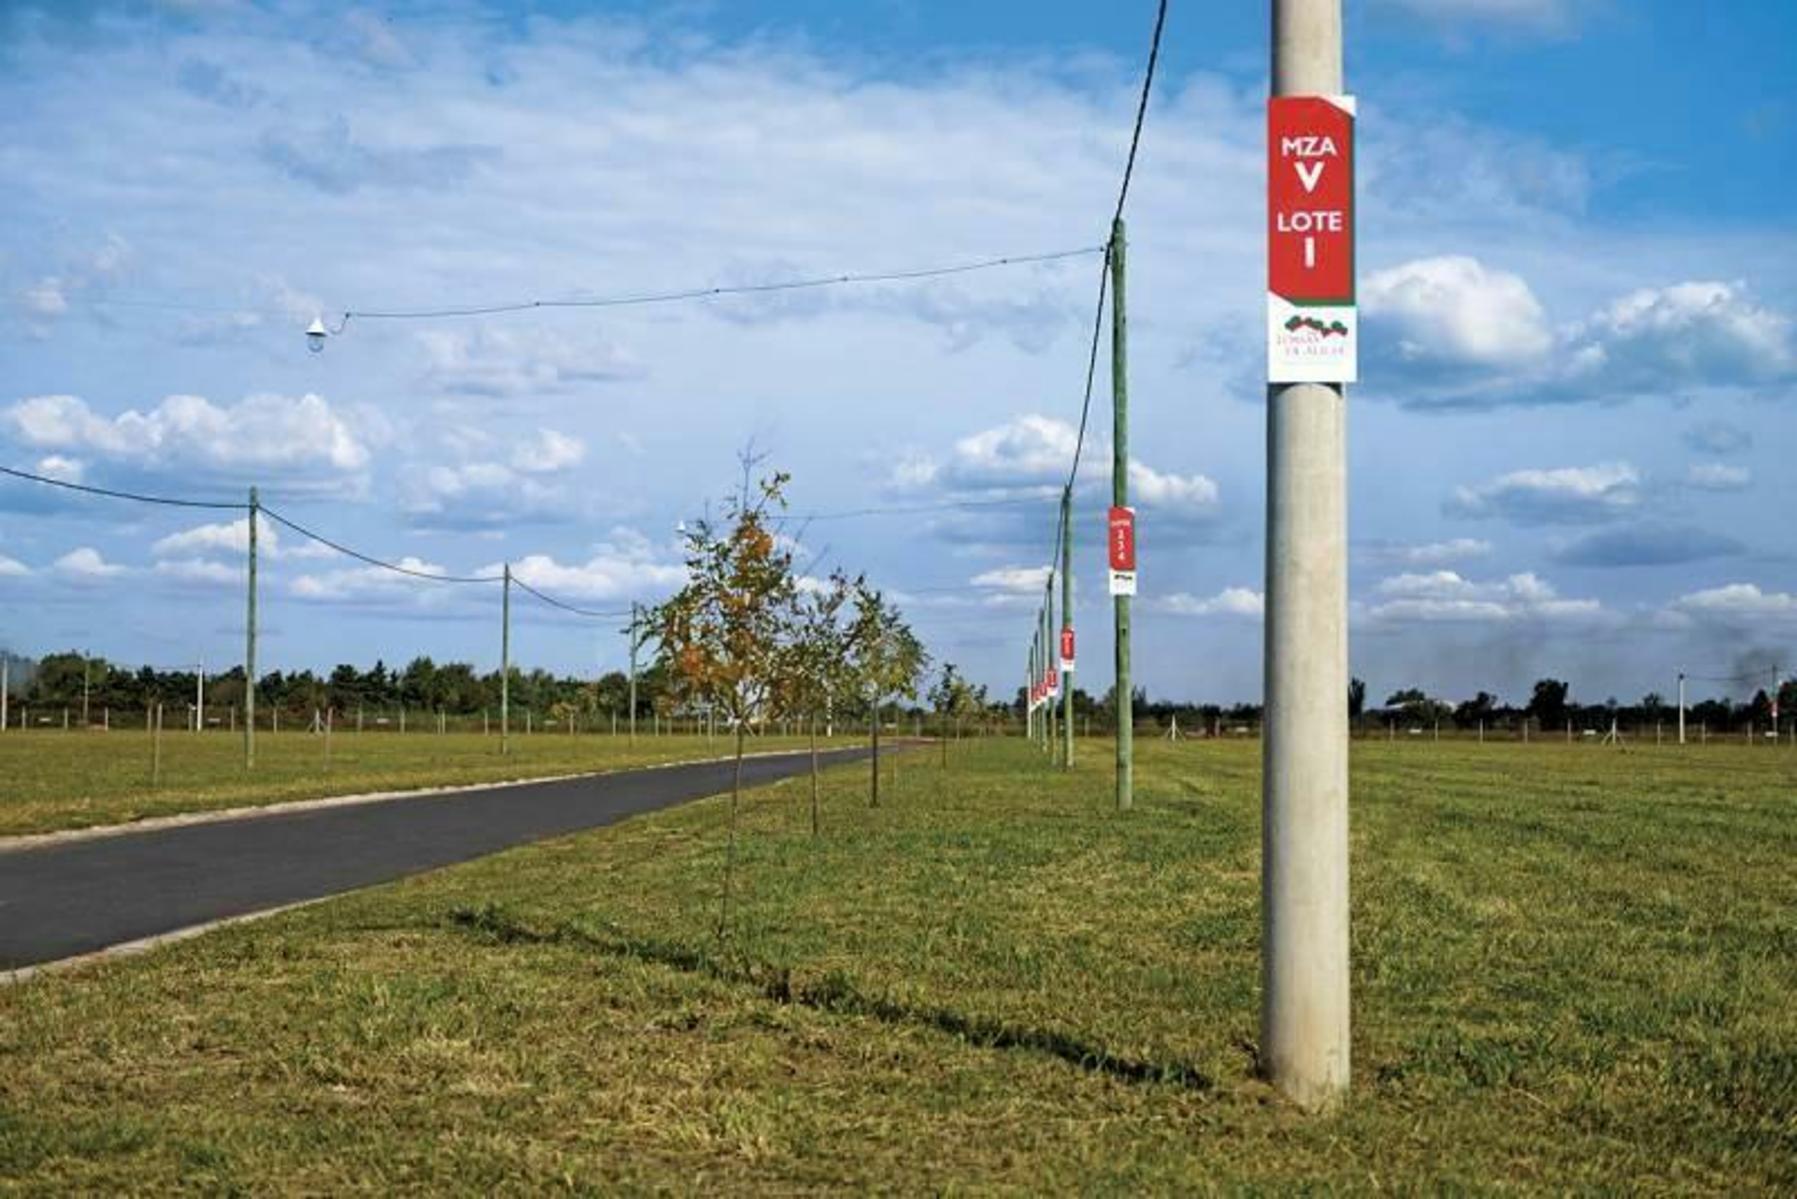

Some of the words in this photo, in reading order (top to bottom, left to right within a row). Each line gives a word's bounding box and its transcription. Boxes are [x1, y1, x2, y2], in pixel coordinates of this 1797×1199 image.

[1282, 136, 1337, 156] MZA
[1294, 161, 1325, 193] V
[1277, 210, 1342, 232] LOTE
